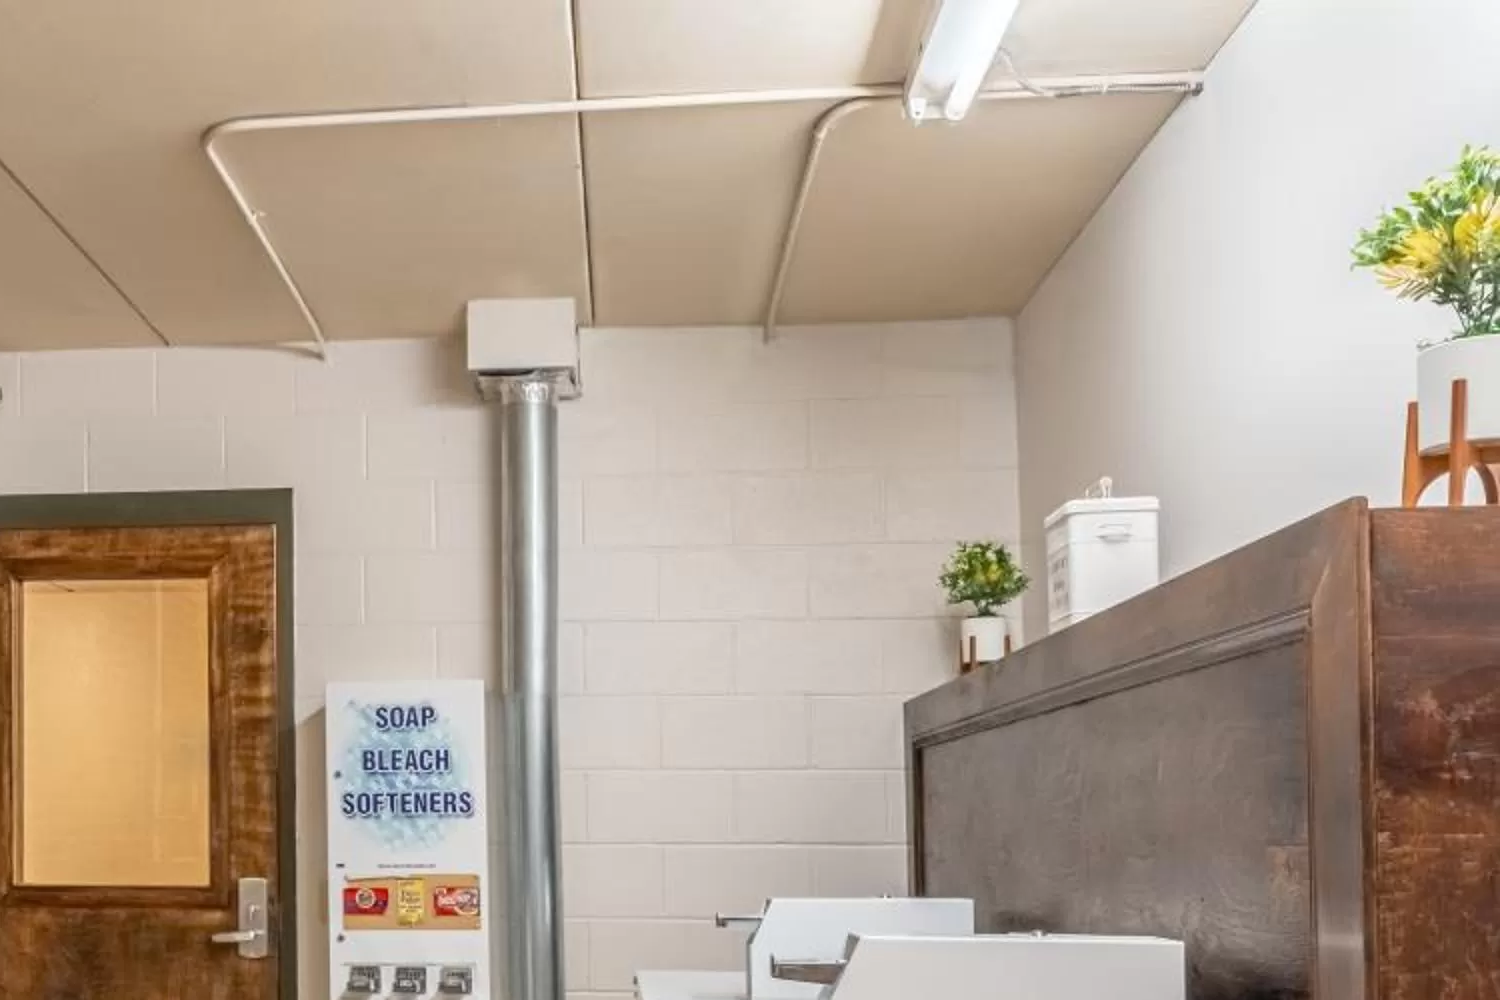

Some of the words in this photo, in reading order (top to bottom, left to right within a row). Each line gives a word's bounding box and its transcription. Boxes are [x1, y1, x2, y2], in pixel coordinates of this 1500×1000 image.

[375, 705, 436, 729] SOAP
[362, 749, 449, 771] BLEACH
[342, 792, 472, 814] SOFTENERS
